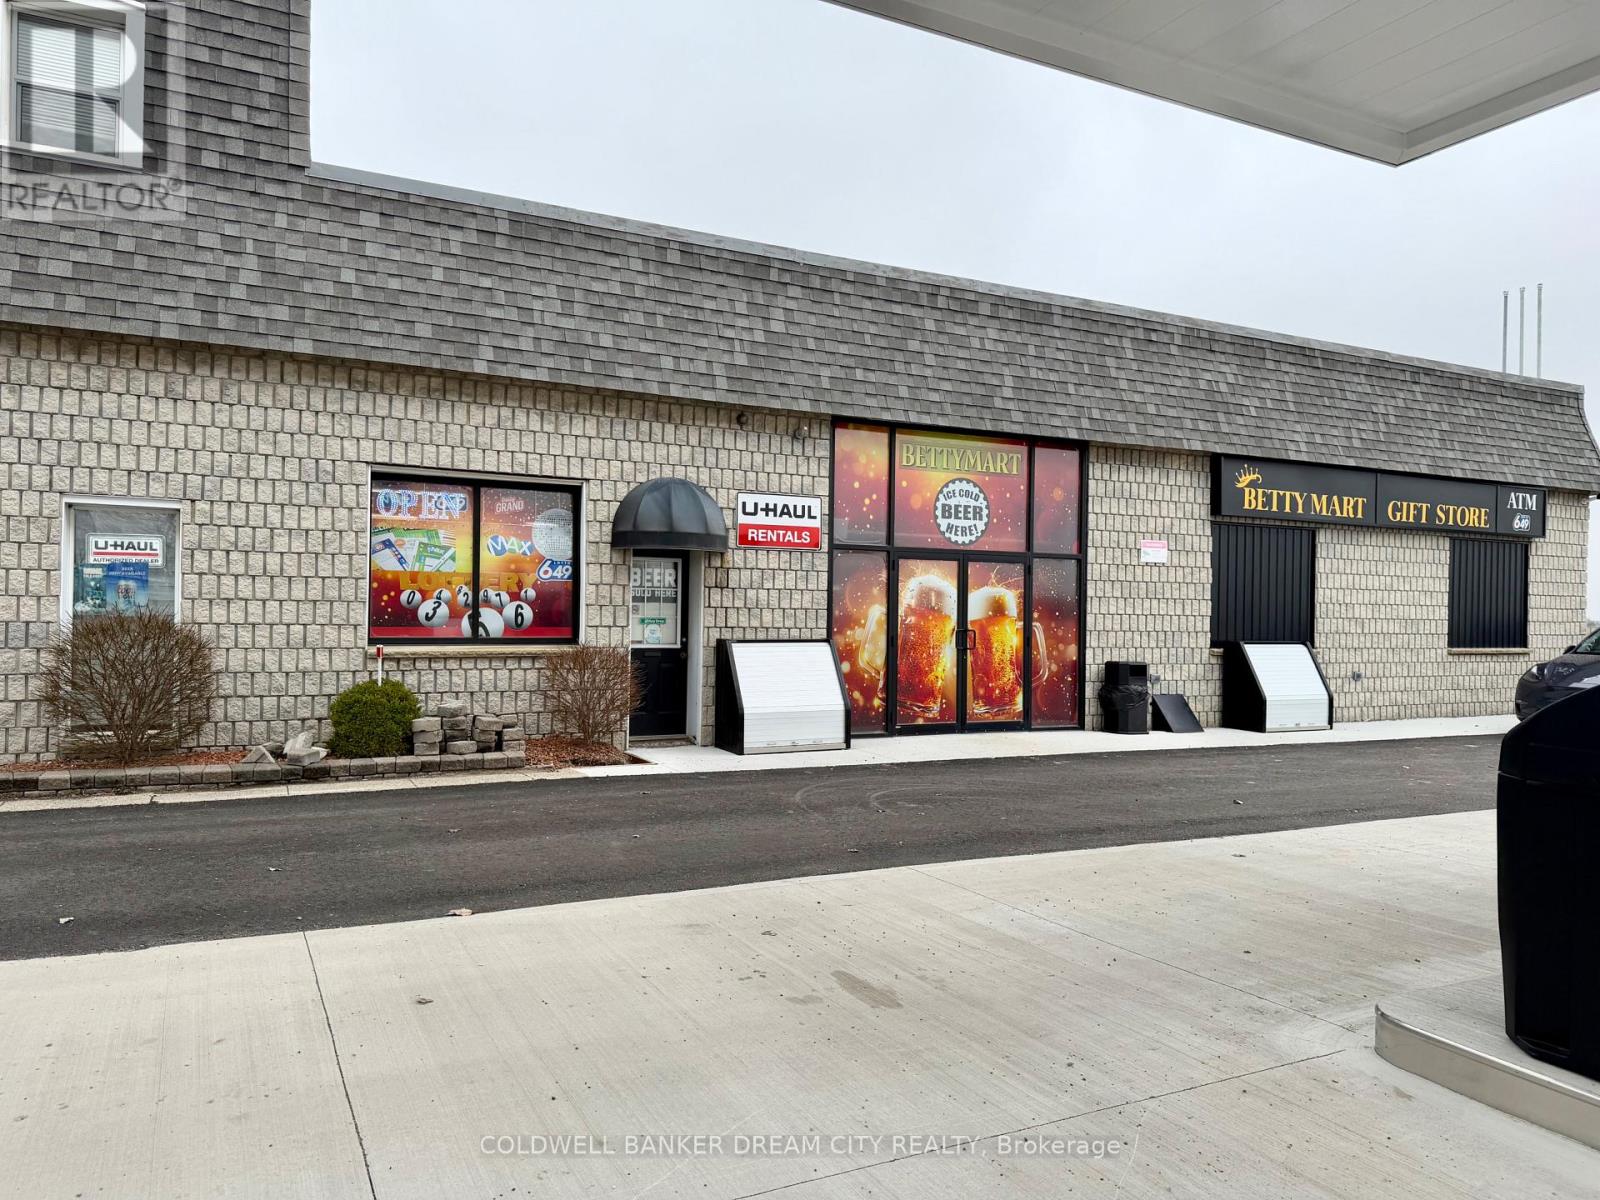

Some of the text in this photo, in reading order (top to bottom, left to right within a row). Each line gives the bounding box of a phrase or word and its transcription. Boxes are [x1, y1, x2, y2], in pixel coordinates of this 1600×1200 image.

[376, 488, 469, 519] OPEN
[943, 488, 980, 502] ICE COLD
[1243, 487, 1367, 518] BETTY MART
[1507, 491, 1537, 511] ATM
[496, 500, 525, 513] GRAND
[742, 501, 818, 519] U-HAUL
[941, 503, 984, 521] BEER
[1387, 500, 1490, 528] GIFT STORE
[747, 528, 811, 543] RENTALS
[945, 522, 979, 538] HERE!
[94, 540, 158, 551] U-HAUL
[487, 534, 534, 557] MAX
[539, 560, 573, 579] 649
[631, 567, 677, 588] BEER
[407, 591, 416, 605] 0
[463, 592, 471, 608] 2
[483, 589, 489, 602] 9
[495, 592, 504, 608] 7
[654, 590, 677, 598] HERE
[425, 600, 442, 622] 3
[514, 604, 525, 628] 6
